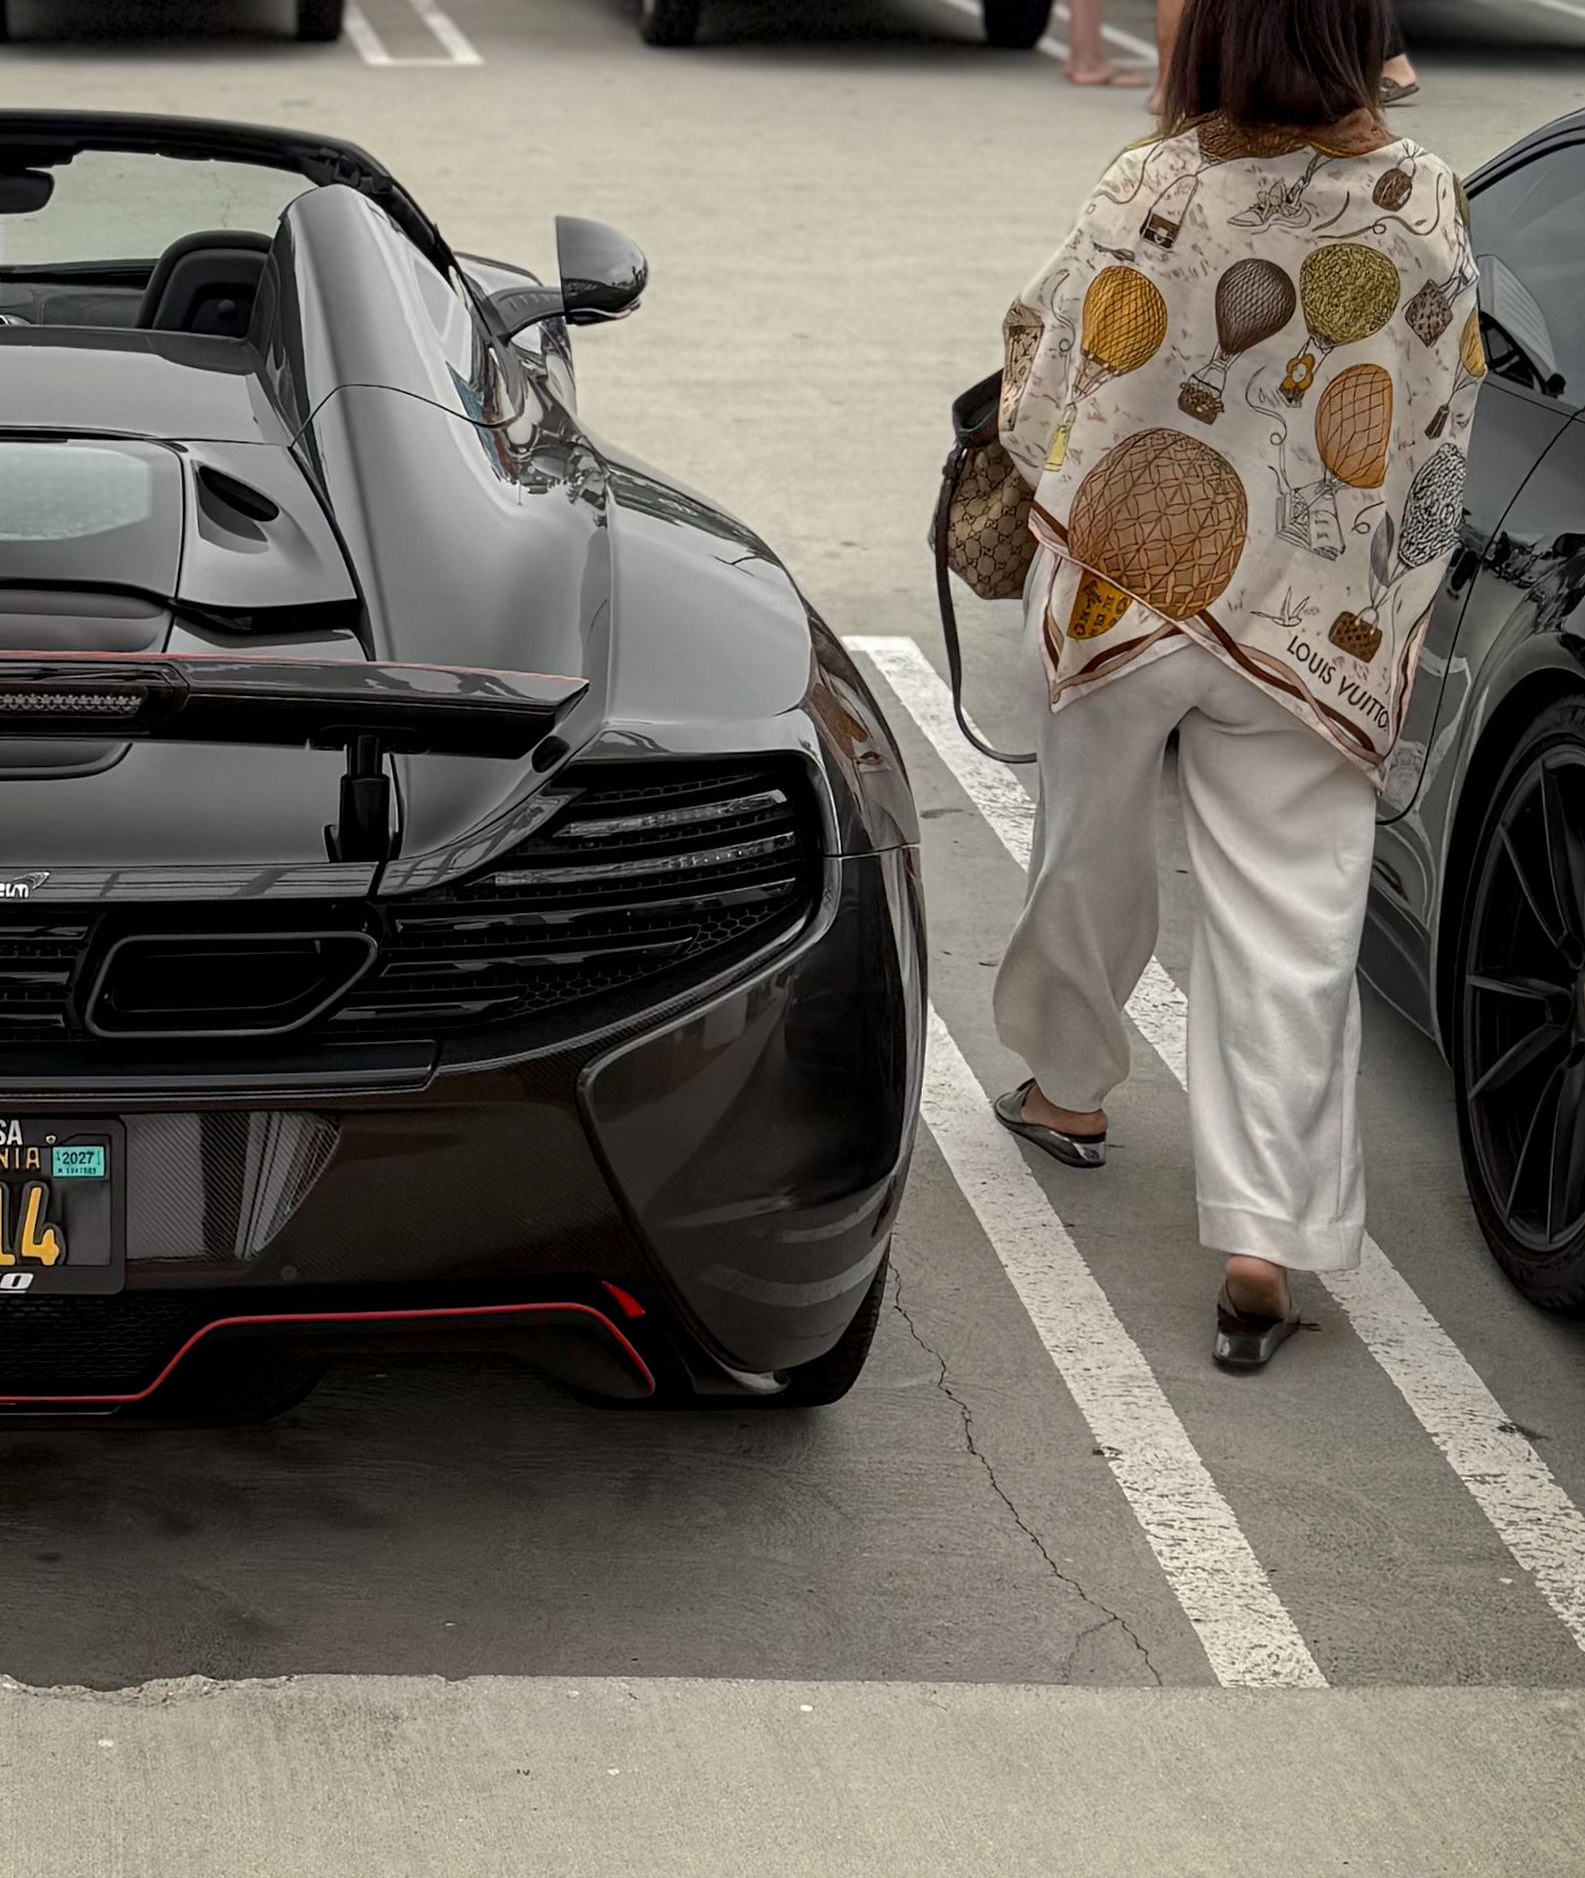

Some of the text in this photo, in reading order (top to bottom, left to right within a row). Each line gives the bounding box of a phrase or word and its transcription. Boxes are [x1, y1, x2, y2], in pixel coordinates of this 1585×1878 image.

[1287, 636, 1390, 732] LOUIS VUITTO
[62, 1152, 94, 1164] 2027
